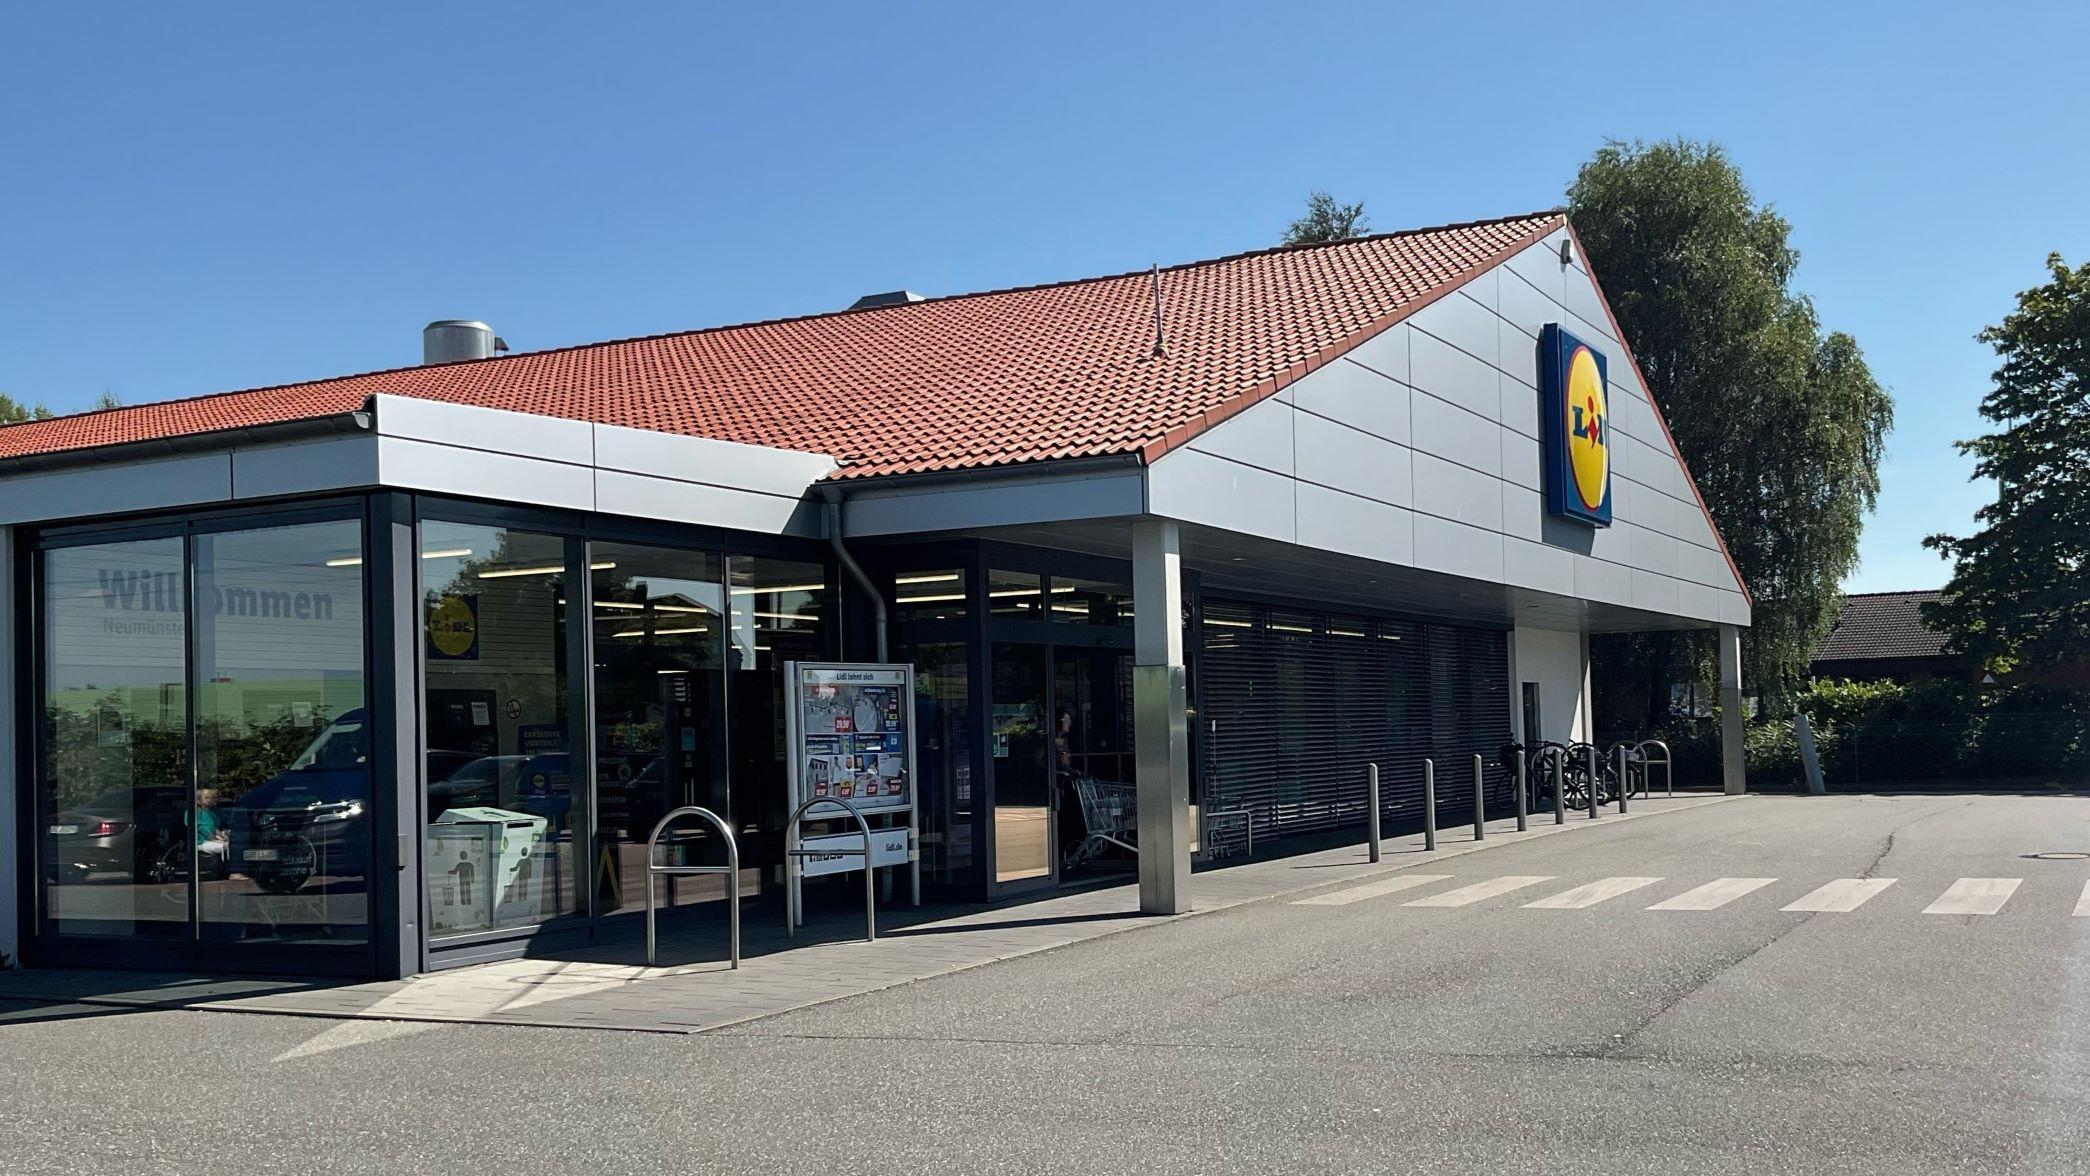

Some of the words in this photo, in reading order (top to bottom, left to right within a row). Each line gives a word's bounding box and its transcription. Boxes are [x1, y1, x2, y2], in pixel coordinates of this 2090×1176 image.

[1572, 395, 1607, 449] LI
[98, 568, 333, 620] Willommen
[103, 616, 184, 635] Neumünste
[885, 842, 903, 852] lidl.de
